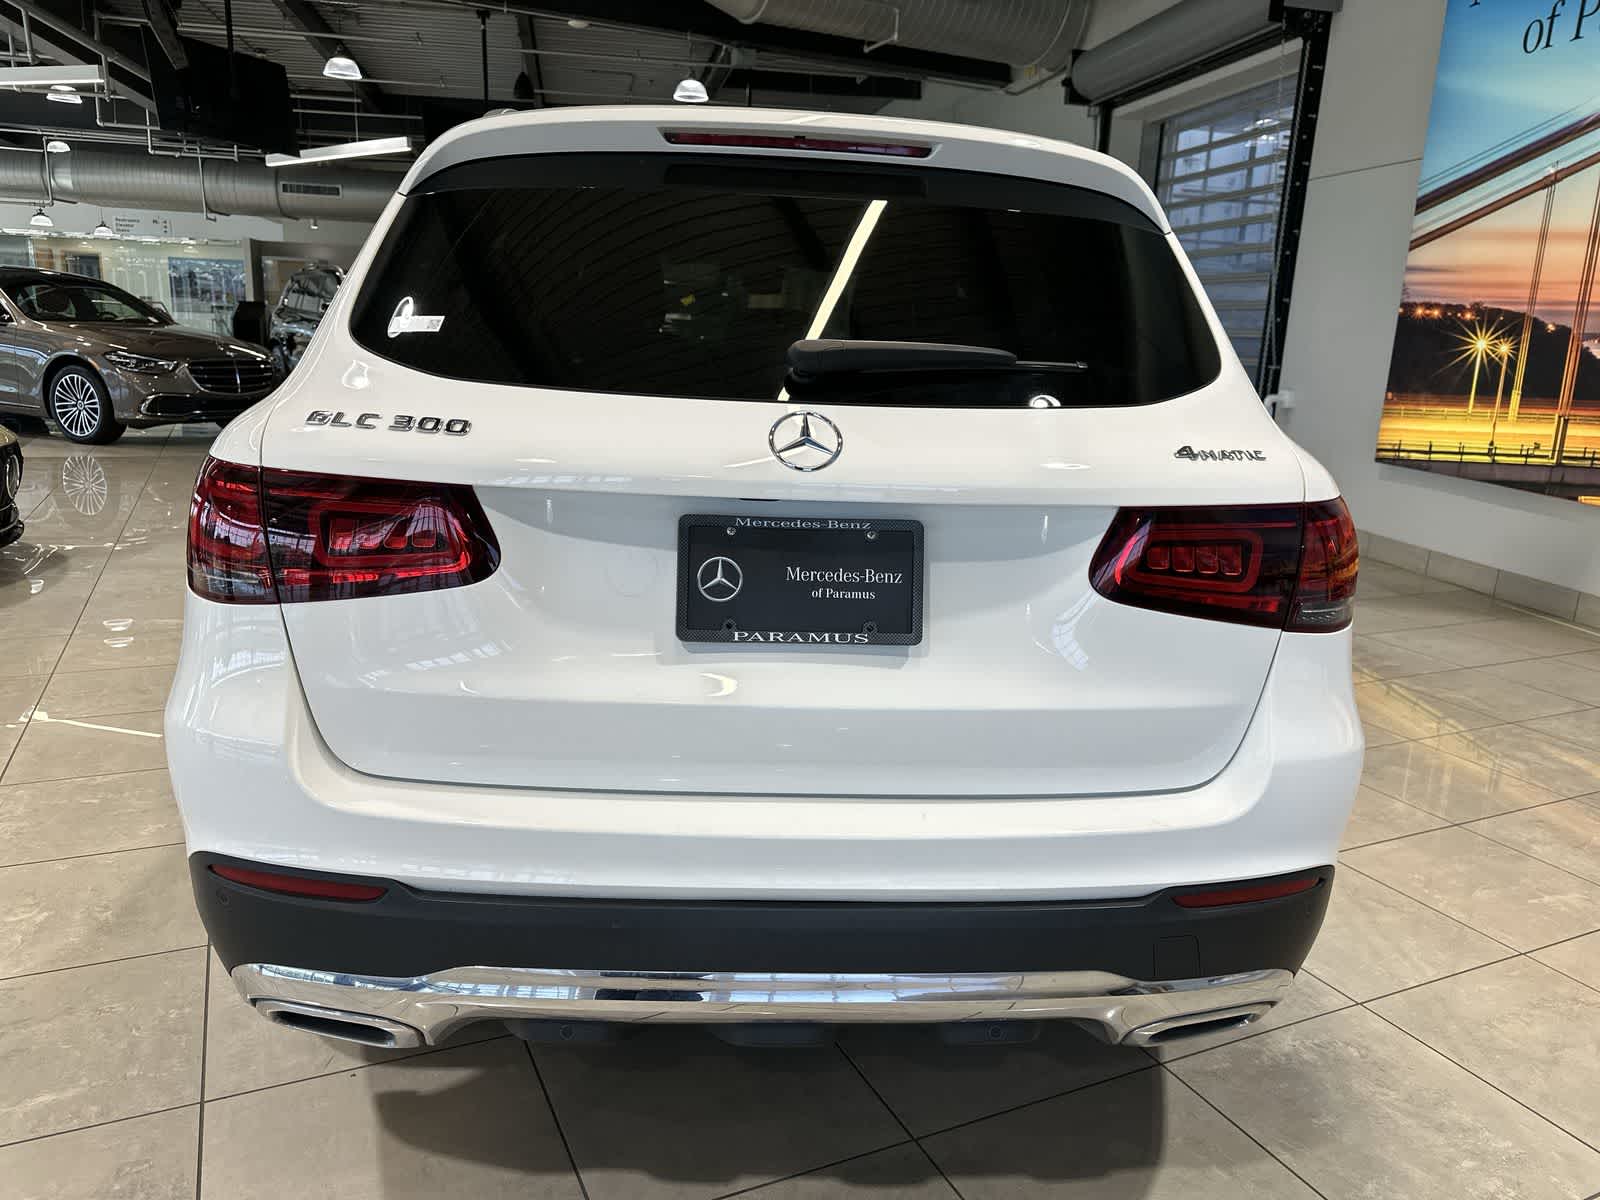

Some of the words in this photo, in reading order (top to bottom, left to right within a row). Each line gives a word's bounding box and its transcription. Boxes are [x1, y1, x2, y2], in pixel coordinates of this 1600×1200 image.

[1523, 0, 1565, 54] of
[1569, 0, 1600, 42] P
[305, 410, 383, 430] GLC
[388, 414, 472, 436] 300
[1174, 445, 1266, 461] 4MATIC
[735, 517, 872, 529] Mercedes-Benz
[786, 566, 903, 584] Mercedes-Benz
[811, 588, 823, 599] of
[826, 588, 876, 600] Paramus
[733, 631, 869, 644] PARAMUS
